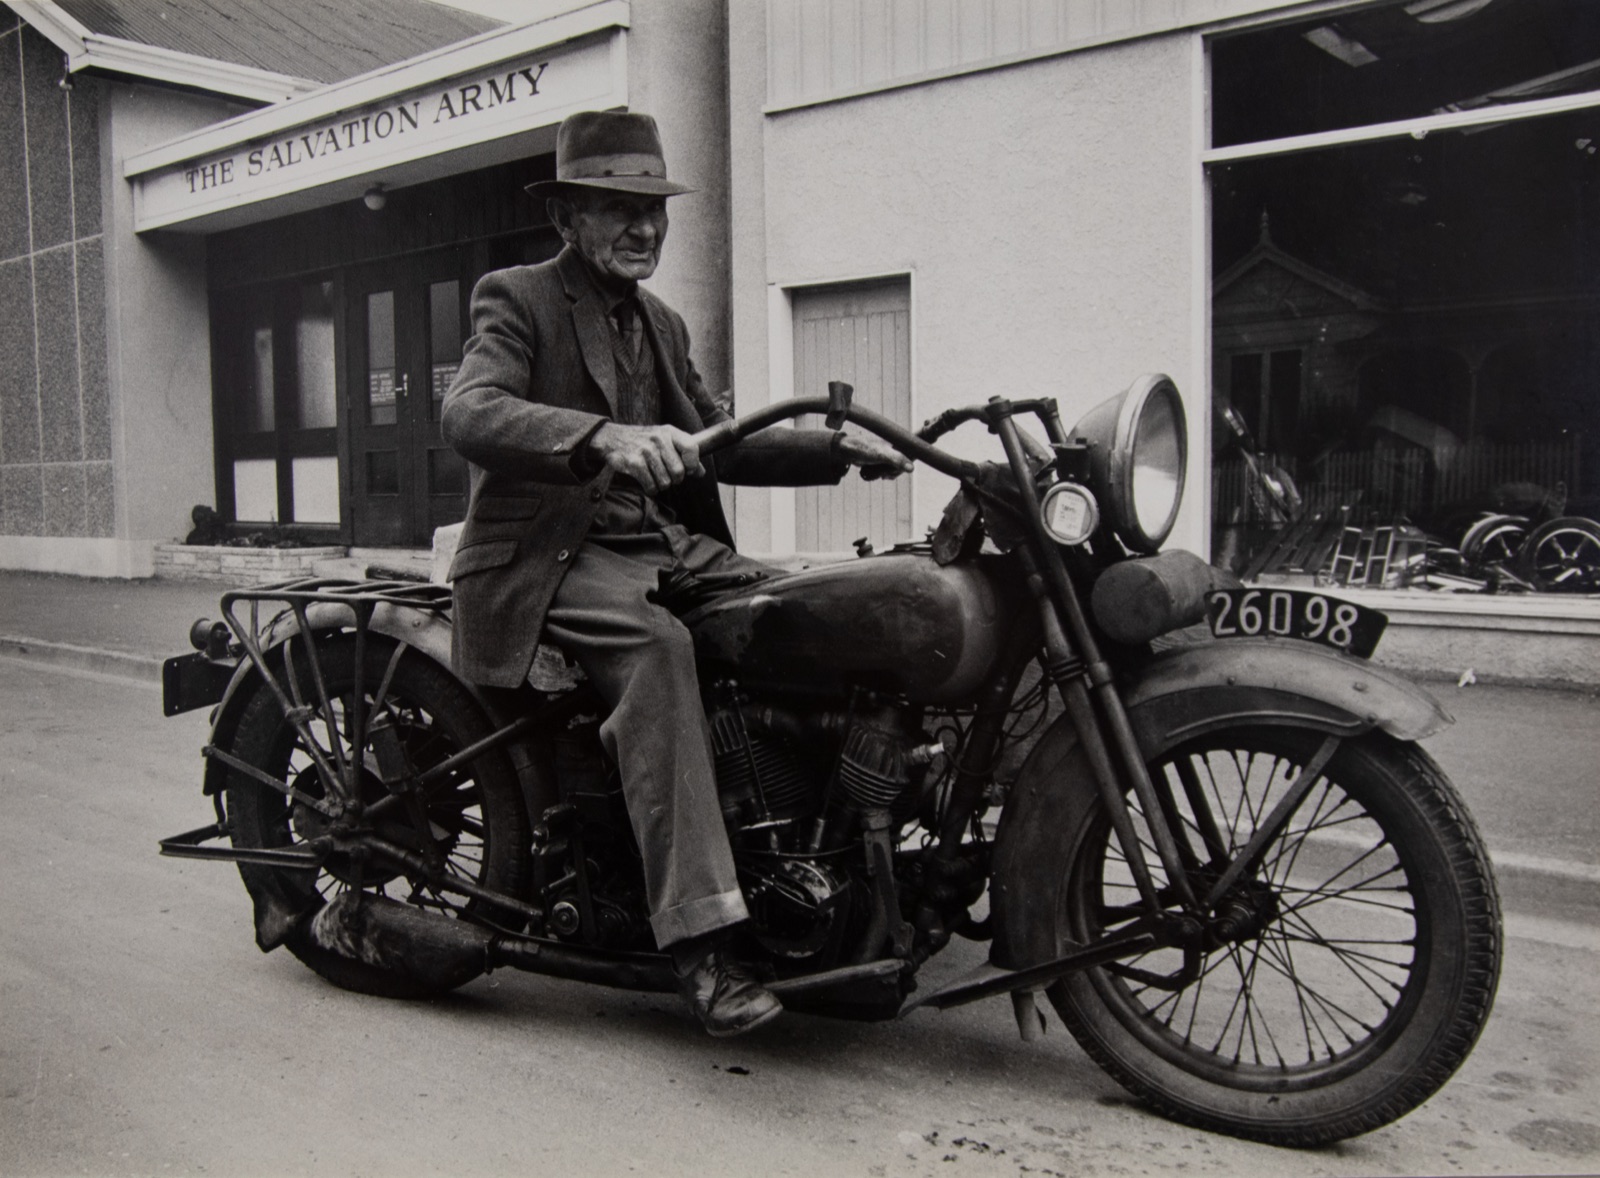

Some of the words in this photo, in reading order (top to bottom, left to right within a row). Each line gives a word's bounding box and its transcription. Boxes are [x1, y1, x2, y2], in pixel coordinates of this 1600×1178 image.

[187, 159, 234, 193] THE
[248, 101, 420, 176] SALVATION
[434, 64, 548, 122] ARMY
